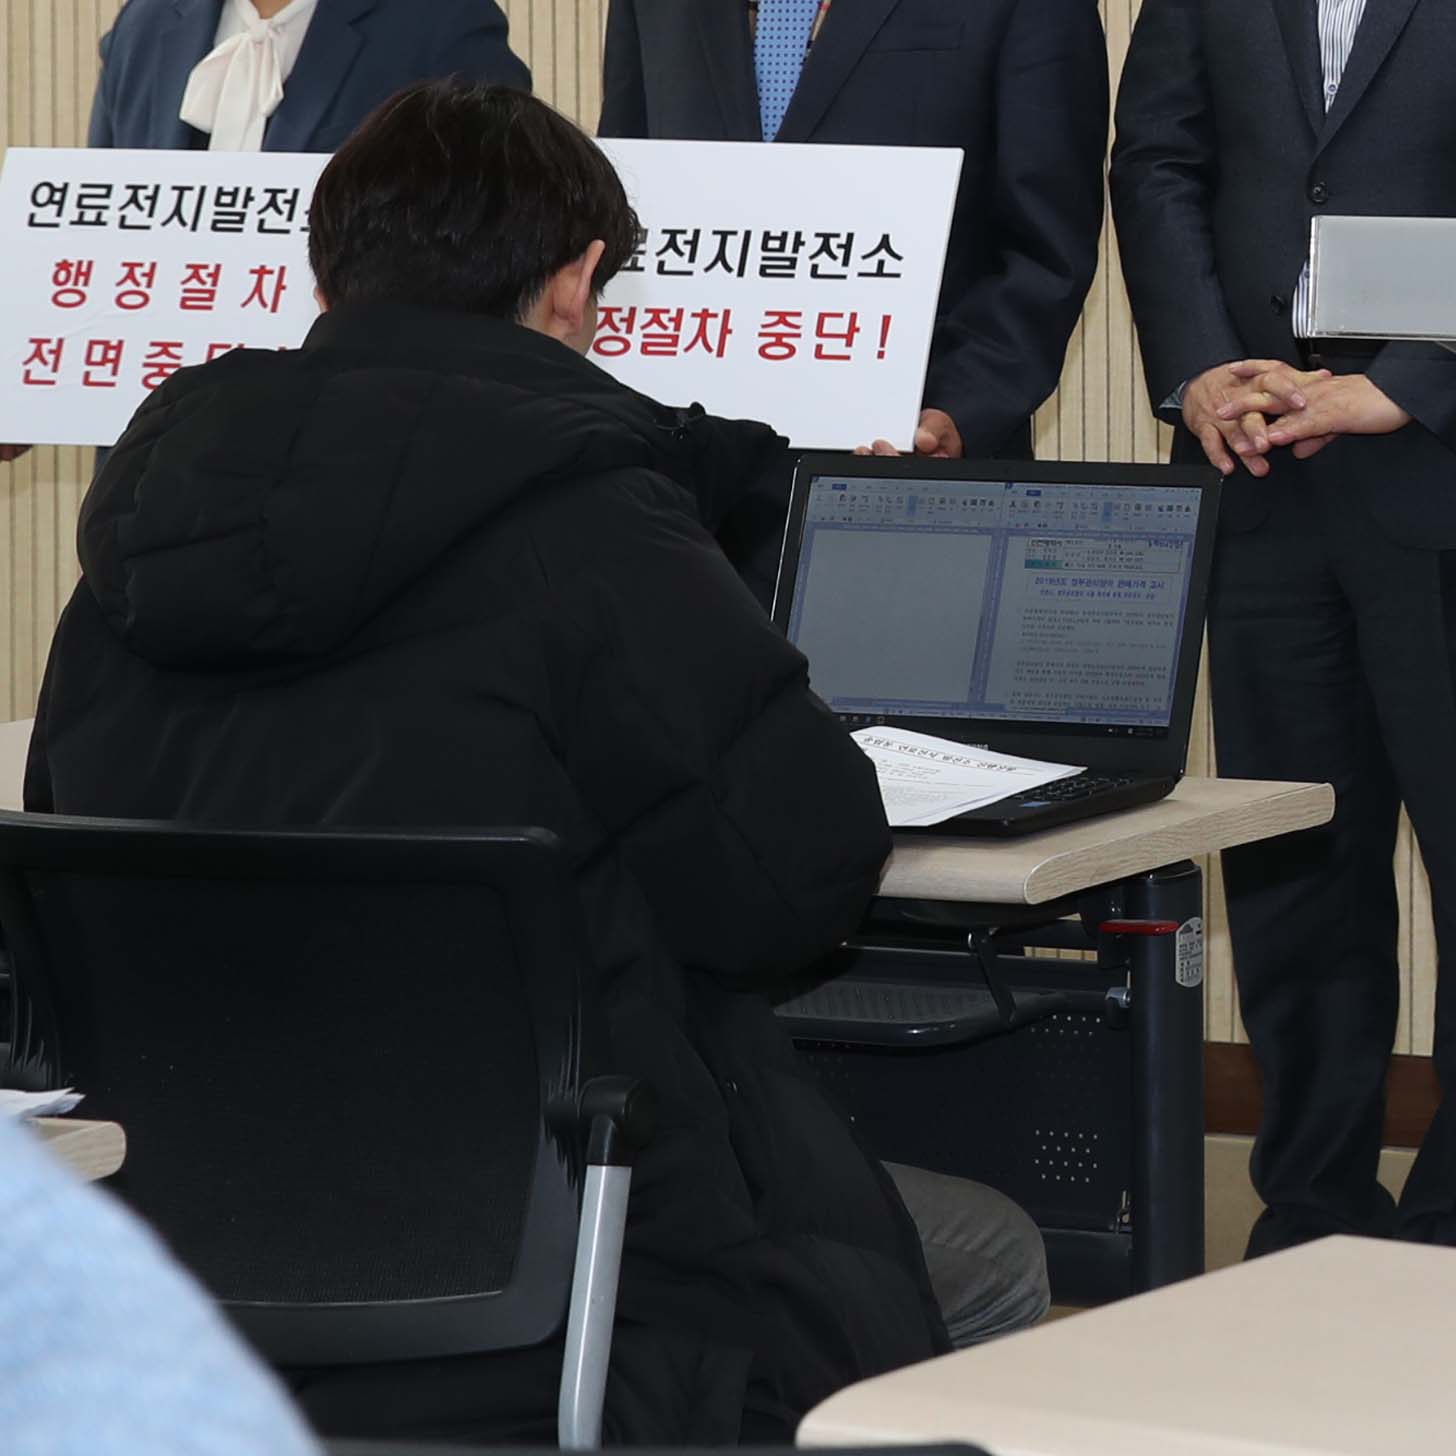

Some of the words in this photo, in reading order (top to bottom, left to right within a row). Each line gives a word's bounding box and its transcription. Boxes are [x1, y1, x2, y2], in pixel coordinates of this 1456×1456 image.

[27, 180, 311, 235] 연료전지발전
[617, 227, 905, 281] 전지발전소
[591, 305, 733, 359] 정절차
